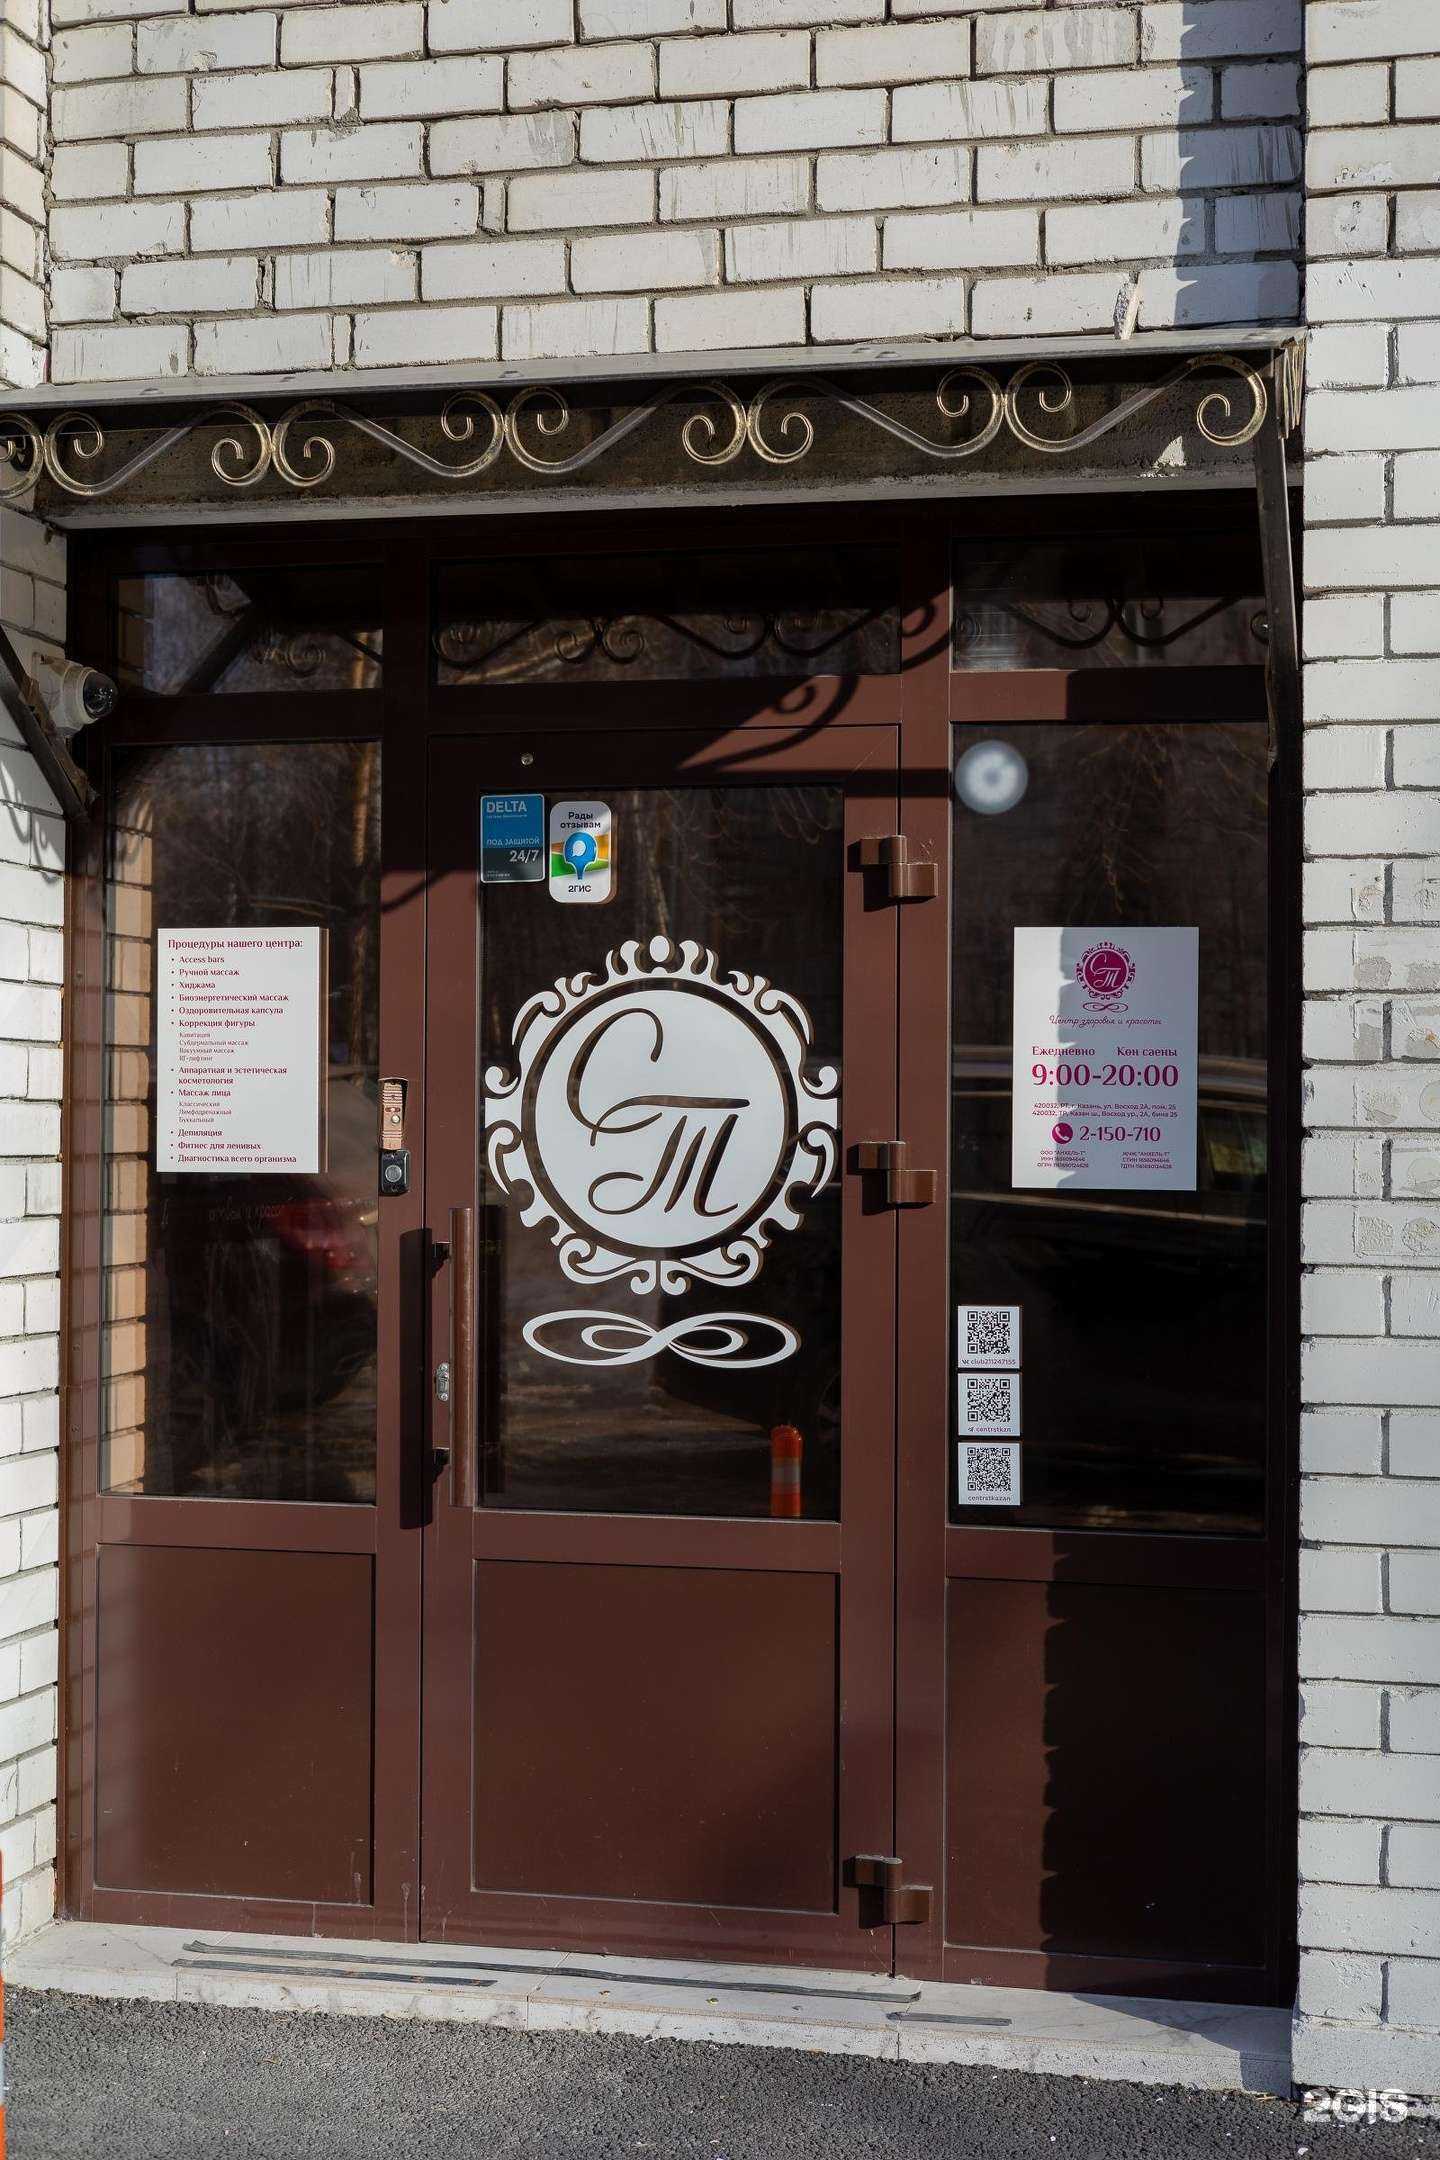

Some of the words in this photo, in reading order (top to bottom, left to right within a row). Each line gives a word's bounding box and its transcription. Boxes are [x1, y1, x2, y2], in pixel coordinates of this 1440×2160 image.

[486, 801, 528, 813] DELTA
[568, 811, 593, 821] Рады
[505, 837, 540, 846] ЗАЩИТОЙ
[509, 849, 540, 864] 24/7
[568, 885, 592, 893] 2ГИС
[168, 939, 225, 950] Процедуры
[227, 940, 263, 948] нашего
[265, 940, 303, 950] центра:
[207, 955, 225, 963] bars
[179, 968, 209, 977] Ручной
[179, 981, 216, 989] Хиджама
[179, 994, 258, 1002] Биоэнергетический
[178, 1007, 250, 1015] Оздоровительная
[251, 1007, 284, 1015] капсула
[178, 1019, 223, 1028] Коррекция
[224, 1019, 256, 1029] фигуры
[1048, 1015, 1079, 1027] Центр
[1079, 1015, 1115, 1028] здоровья
[1125, 1017, 1163, 1028] красоты
[1031, 1045, 1096, 1058] Ежедневно
[1116, 1046, 1139, 1057] Көн
[1142, 1048, 1178, 1057] саены
[179, 1066, 225, 1075] Аппаратная
[1031, 1063, 1179, 1087] 9:00-20:00
[178, 1077, 234, 1085] косметология
[178, 1089, 209, 1097] Массаж
[211, 1090, 231, 1098] лица
[1114, 1103, 1139, 1111] Восход
[178, 1129, 223, 1138] Депиляция
[1079, 1125, 1161, 1142] 2-150-710
[178, 1142, 208, 1150] Фитнес
[178, 1155, 229, 1163] Диагностика
[254, 1156, 297, 1164] организма
